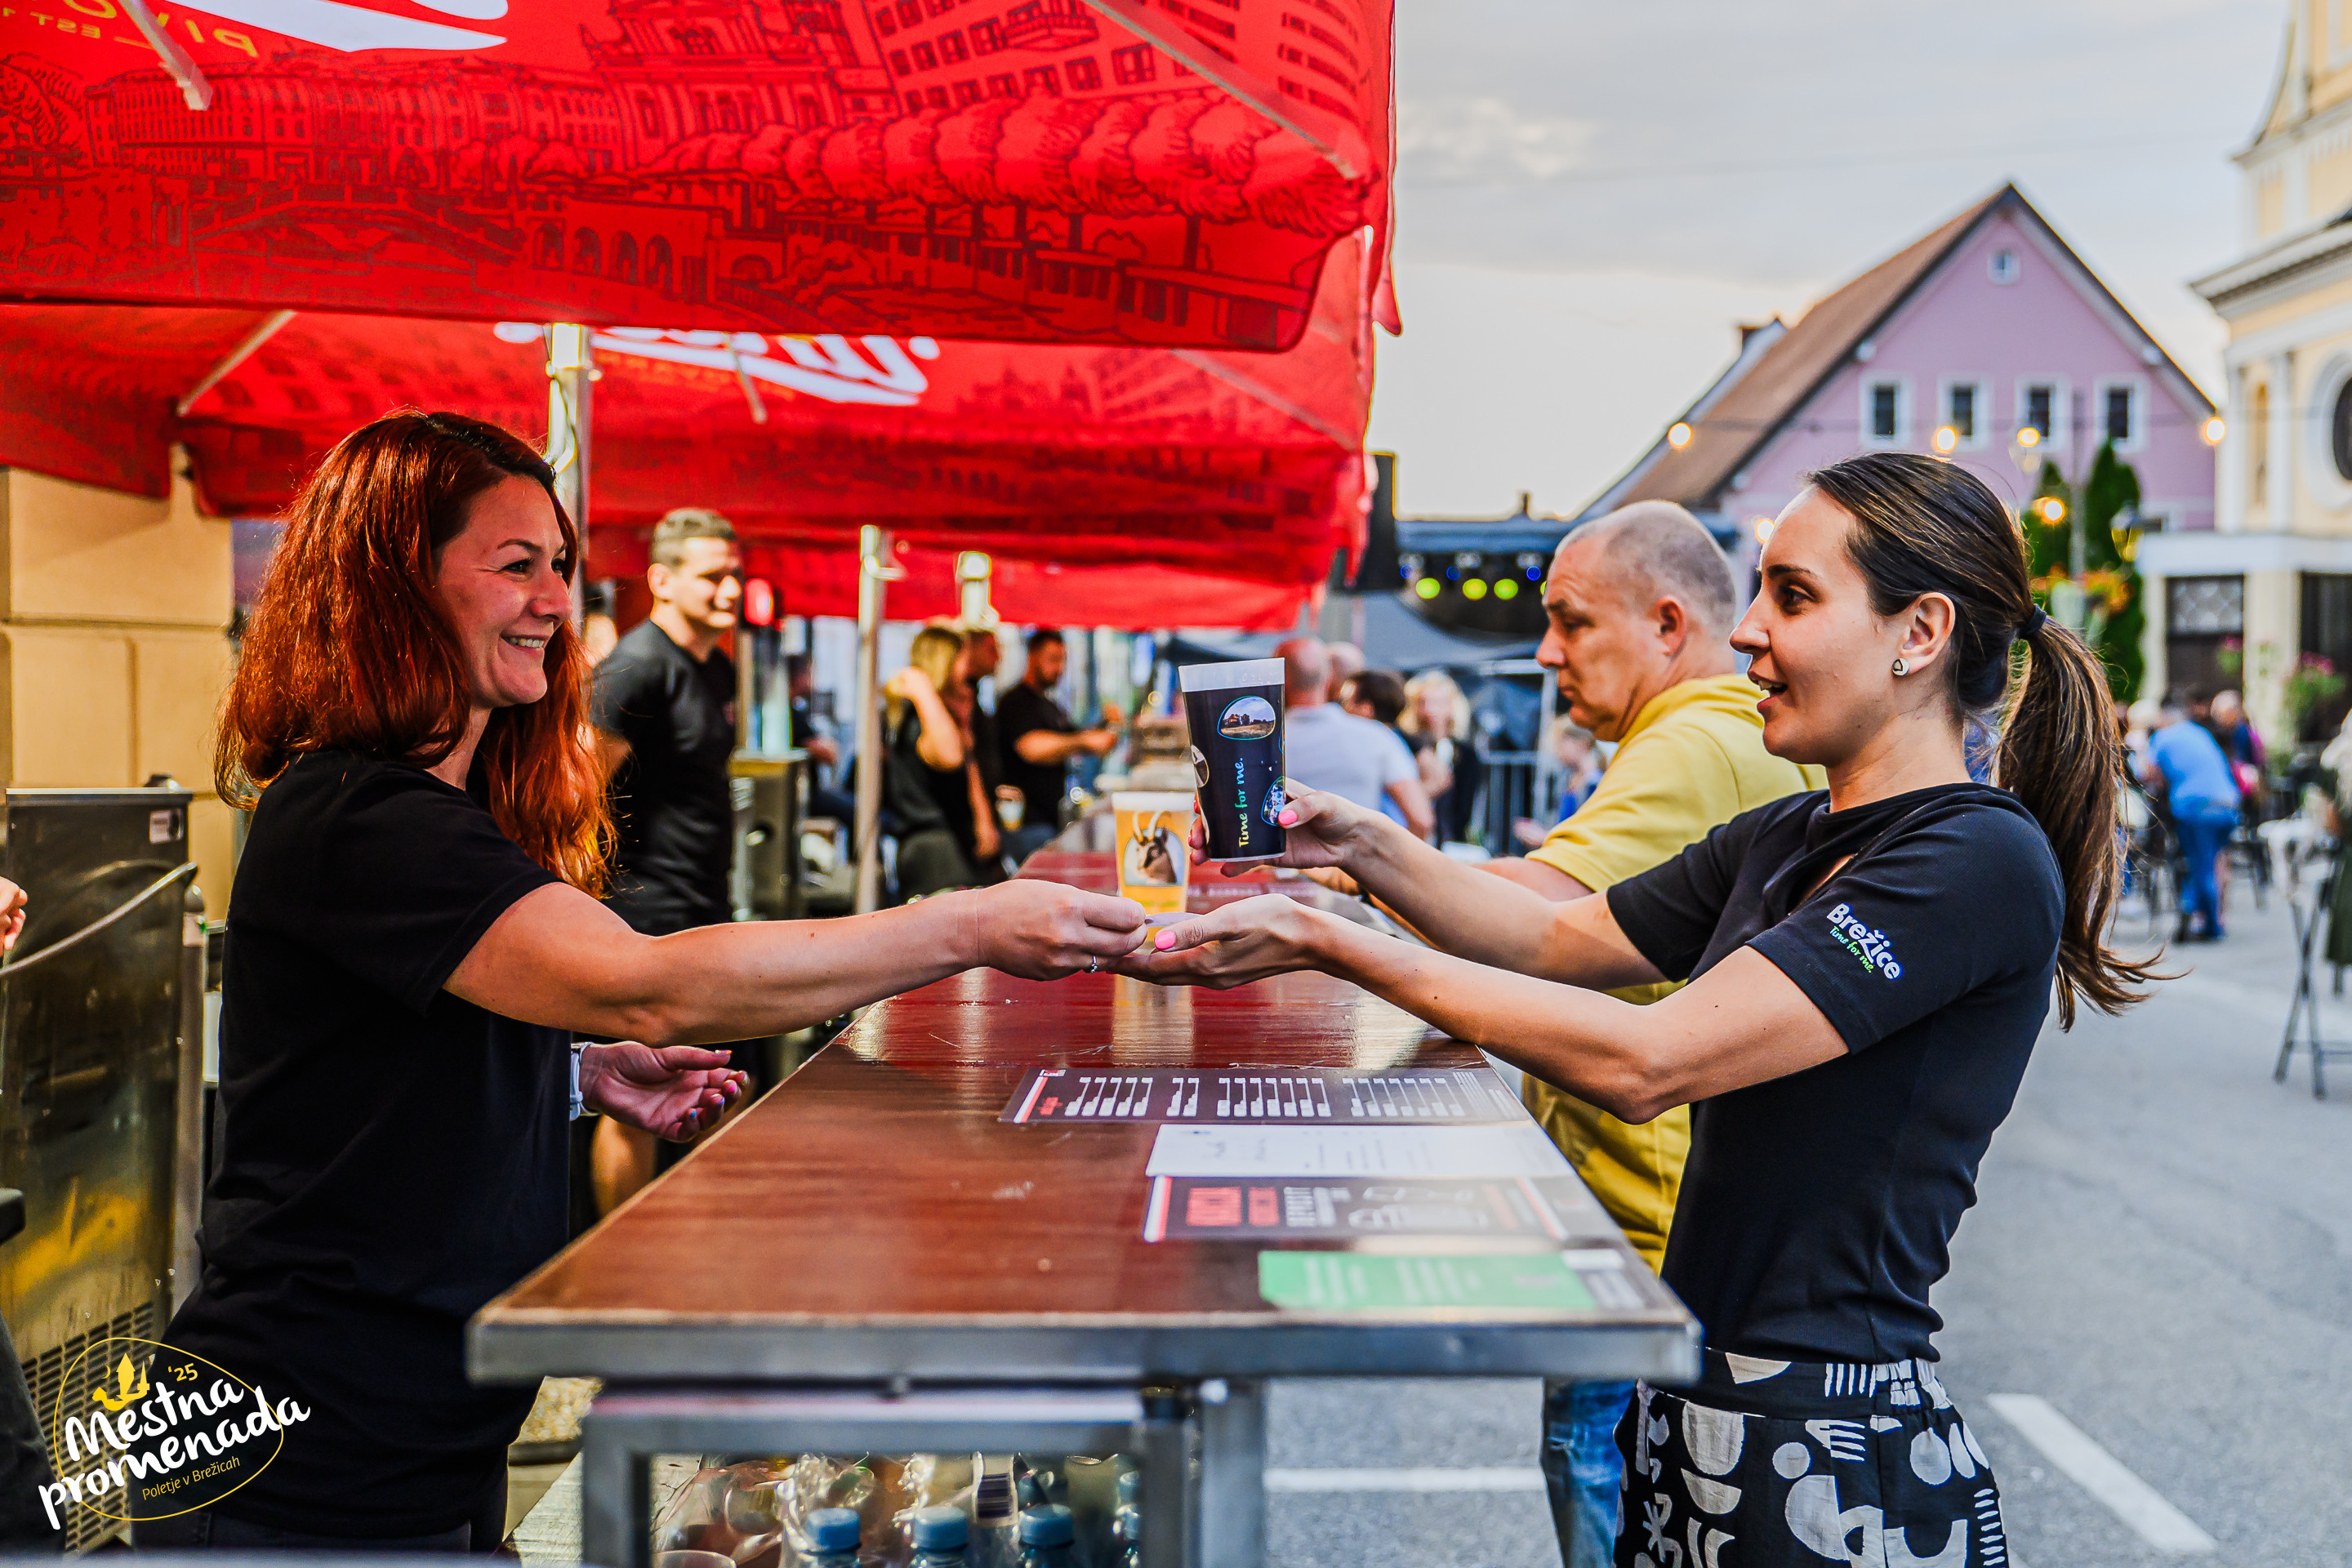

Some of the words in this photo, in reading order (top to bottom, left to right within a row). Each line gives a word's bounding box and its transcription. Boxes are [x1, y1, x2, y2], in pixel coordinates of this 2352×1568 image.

[1234, 756, 1245, 785] me.
[1234, 788, 1248, 808] for
[1238, 812, 1250, 848] Time
[1826, 902, 1903, 980] Brežice
[1829, 925, 1850, 944] Time
[1846, 941, 1861, 956] for
[1859, 955, 1874, 973] me.
